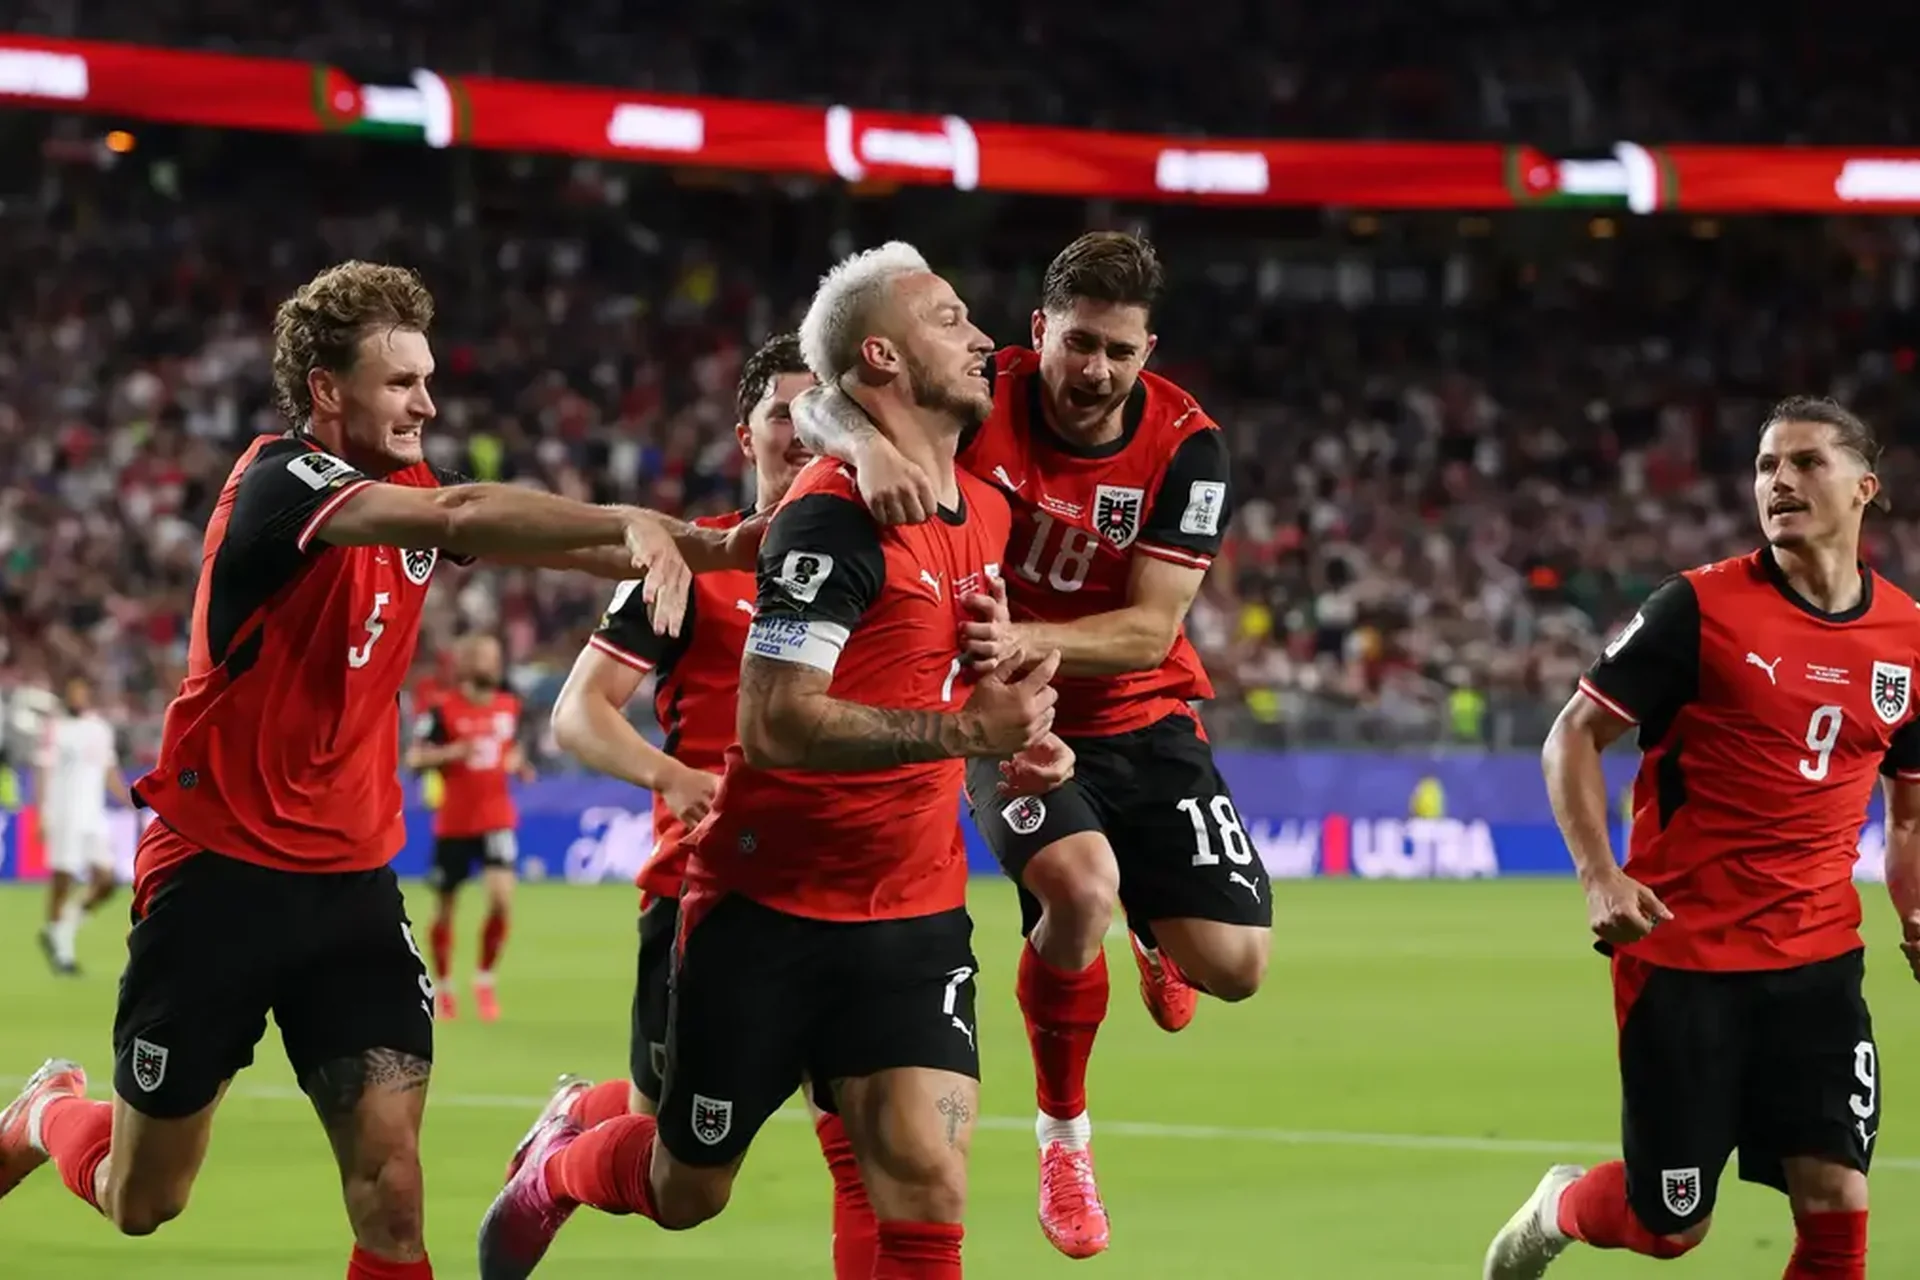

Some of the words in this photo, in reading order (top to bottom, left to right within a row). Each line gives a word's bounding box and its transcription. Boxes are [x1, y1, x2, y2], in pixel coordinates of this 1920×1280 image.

[1015, 510, 1099, 592] 18
[348, 591, 390, 668] 5
[1798, 705, 1844, 782] 9
[1176, 795, 1253, 866] 18
[1351, 817, 1500, 877] ULTRA
[943, 966, 973, 1015] 7
[1848, 1040, 1875, 1119] 9
